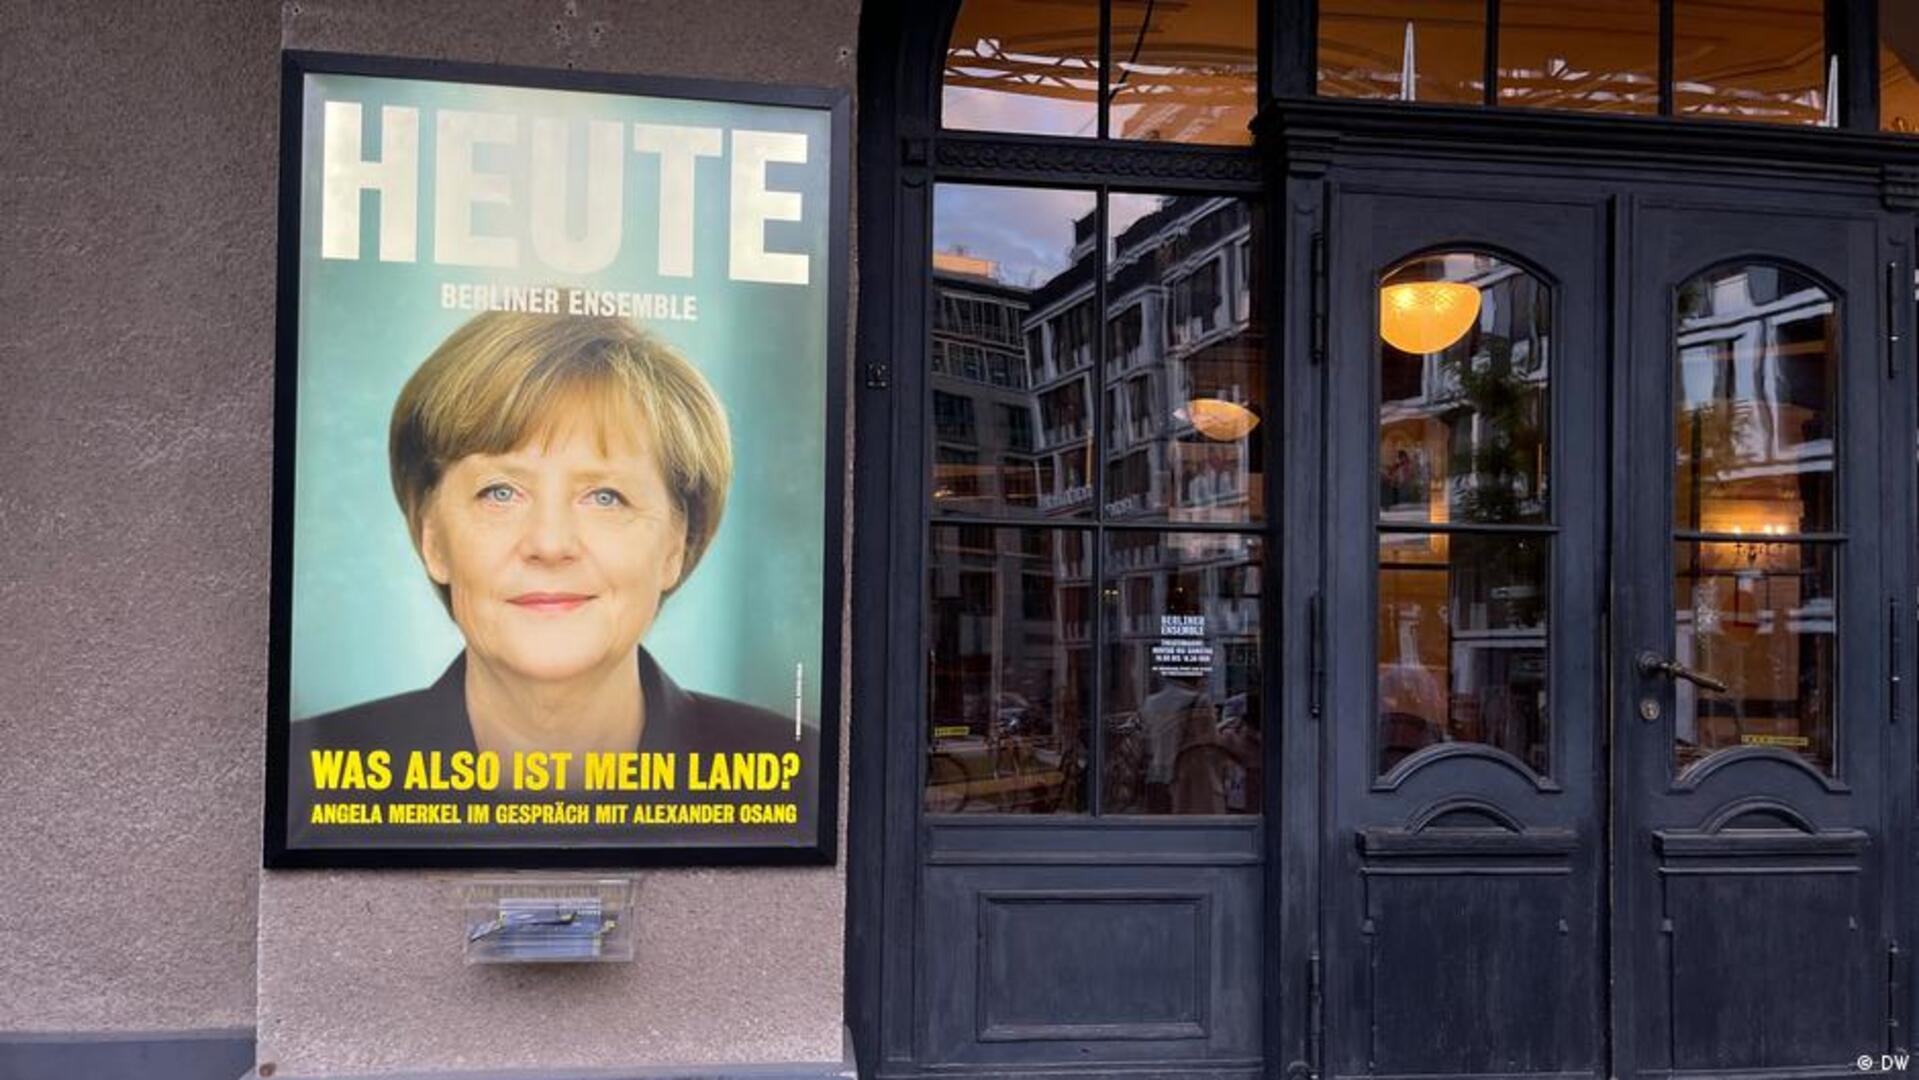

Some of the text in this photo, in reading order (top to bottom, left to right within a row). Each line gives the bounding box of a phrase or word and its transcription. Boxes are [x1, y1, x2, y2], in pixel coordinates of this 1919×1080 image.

[322, 100, 809, 285] HEUTE
[440, 283, 698, 320] BERLINER ENSEMBLE
[1160, 615, 1205, 626] BERLINER
[1160, 625, 1205, 636] ENSEMBLE
[310, 749, 801, 791] WAS ALSO IST MEIN LAND?
[311, 801, 798, 825] ANGELA MERKEL IM GESPRÄCH MIT ALEXANDER OSANG
